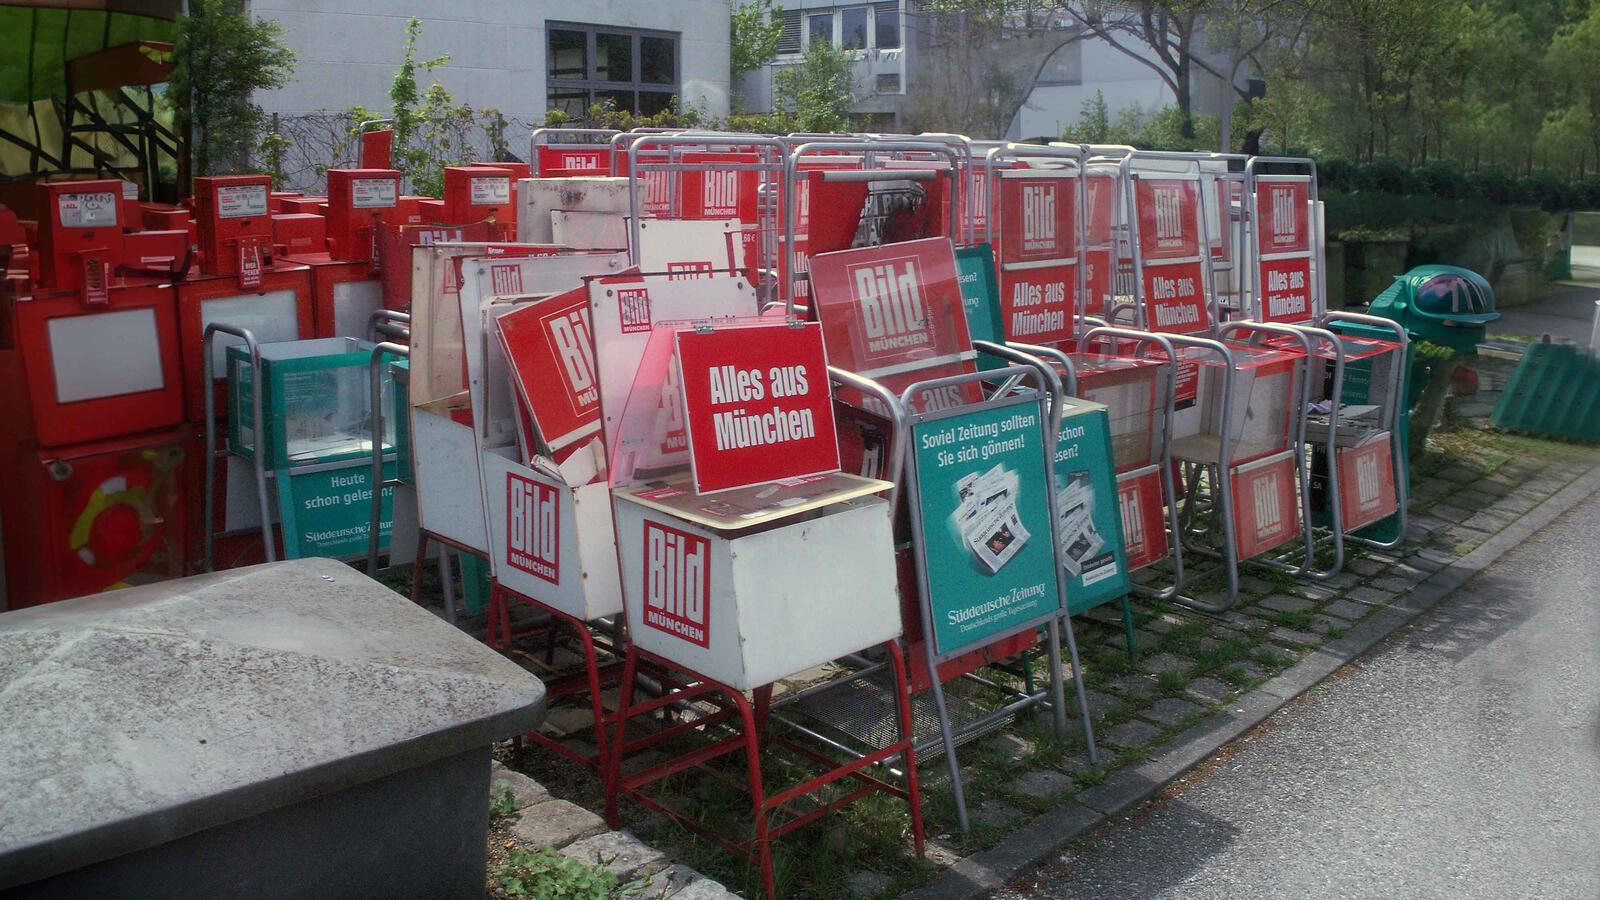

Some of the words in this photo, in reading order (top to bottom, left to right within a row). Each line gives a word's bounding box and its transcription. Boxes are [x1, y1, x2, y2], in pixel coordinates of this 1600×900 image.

[704, 170, 737, 207] Bild
[1023, 186, 1056, 240] Bild
[1154, 187, 1182, 238] Bild
[1272, 188, 1296, 234] Bild
[1024, 240, 1056, 250] MÜNCHEN
[957, 272, 977, 284] esen?
[1153, 277, 1176, 299] Alles
[1178, 277, 1195, 296] aus
[1268, 270, 1288, 291] Alles
[1290, 270, 1304, 288] aus
[620, 291, 649, 325] Bild
[856, 262, 926, 338] Bild
[1013, 283, 1042, 307] Alles
[1045, 282, 1065, 303] aus
[1269, 294, 1306, 317] München
[623, 325, 650, 333] MÜNCHEN
[1012, 308, 1064, 337] München
[1155, 303, 1199, 327] München
[549, 307, 597, 393] Bi
[868, 333, 928, 352] MÜNCHEN
[709, 366, 764, 404] Alles
[770, 365, 809, 397] aus
[713, 407, 815, 451] München
[922, 428, 955, 449] Soviel
[958, 421, 998, 443] Zeitung
[1001, 414, 1035, 431] sollten
[1058, 426, 1084, 442] schon
[938, 451, 955, 467] Sie
[958, 445, 979, 462] sich
[982, 435, 1025, 459] gönnen!
[1054, 444, 1079, 463] esen?
[331, 473, 365, 488] Heute
[1356, 452, 1380, 502] Bild
[305, 494, 340, 509] schon
[344, 486, 393, 505] gelesn?
[1253, 473, 1281, 530] Bild
[304, 525, 366, 543] Süddeutsche
[511, 477, 555, 565] Bild
[510, 552, 556, 580] MÜNCHEN
[649, 526, 704, 625] Bild
[948, 595, 1010, 626] Süddeutsche
[1009, 583, 1046, 604] Zeitung
[648, 611, 704, 642] MÜNCHEN
